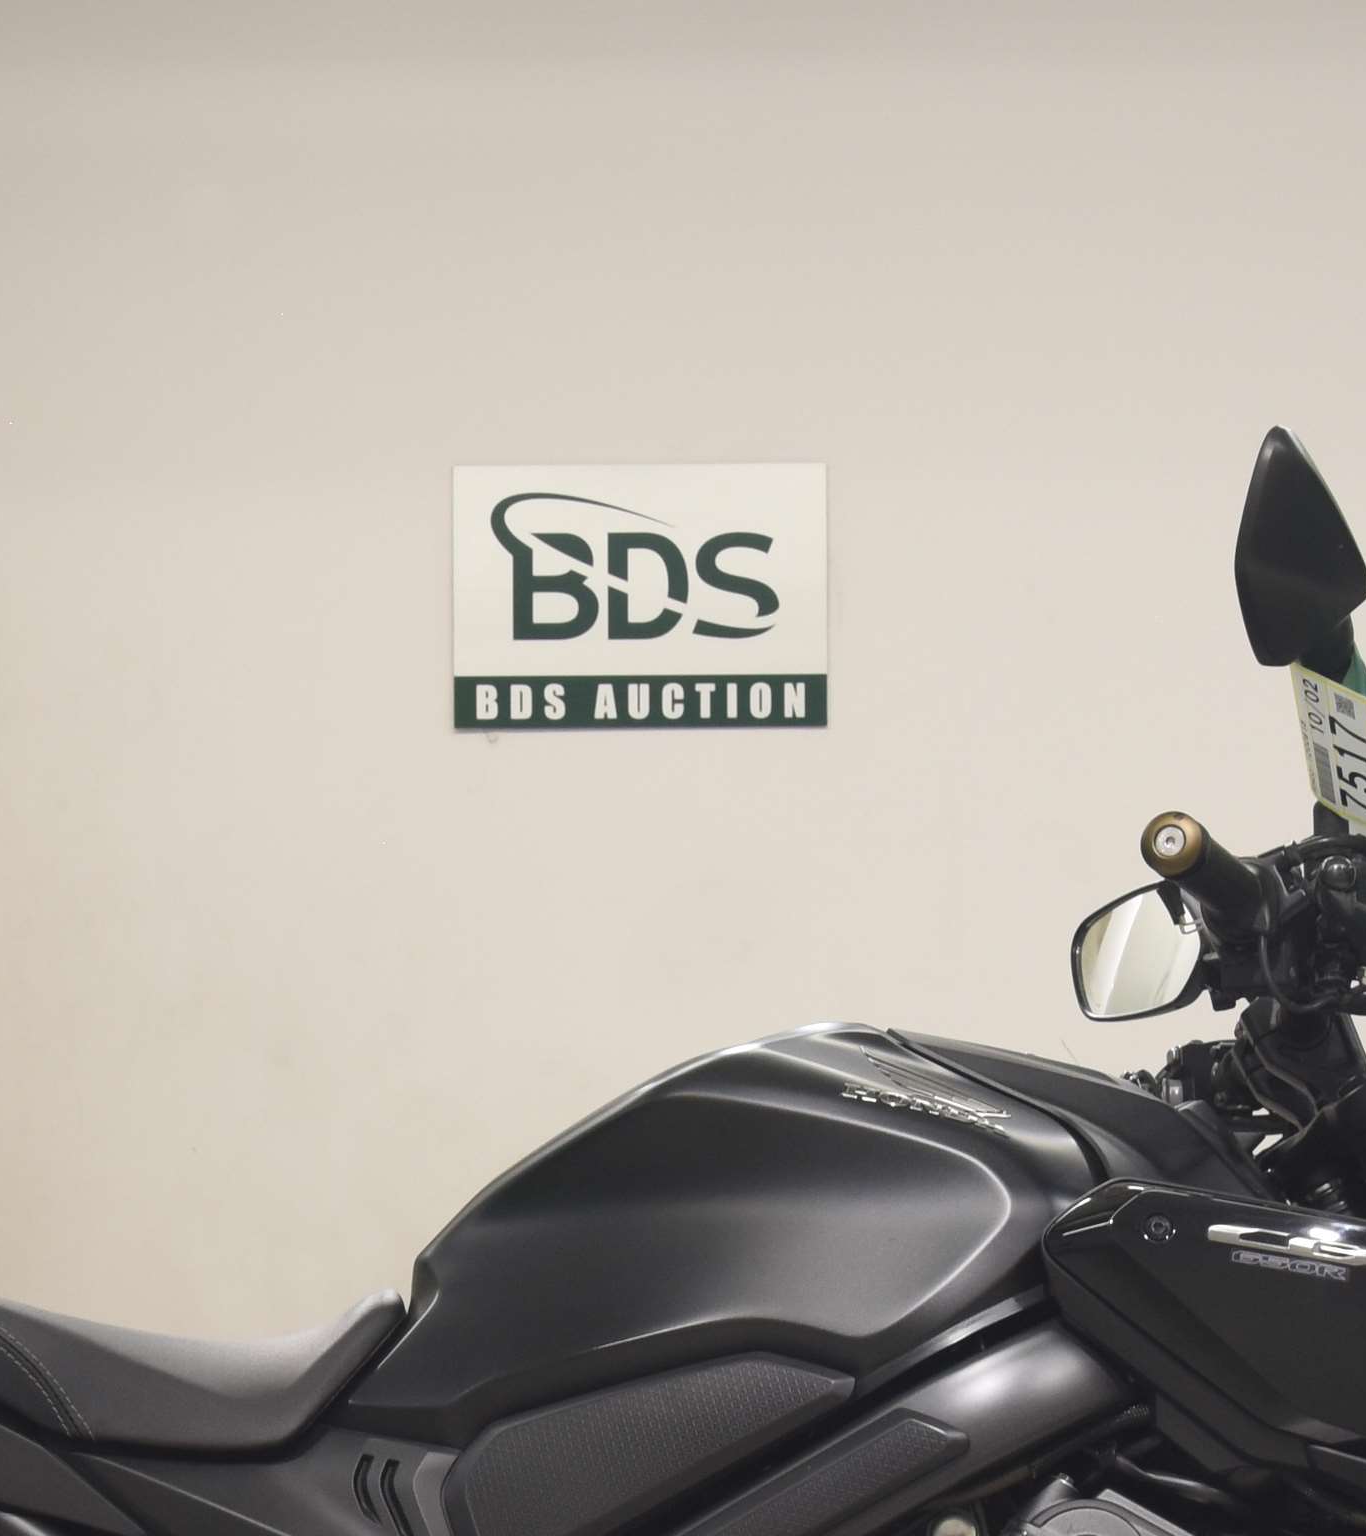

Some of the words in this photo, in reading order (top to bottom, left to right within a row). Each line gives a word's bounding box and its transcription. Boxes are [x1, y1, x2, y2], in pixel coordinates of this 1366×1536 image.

[490, 491, 780, 640] BDS
[474, 683, 567, 720] BDS
[593, 682, 807, 719] AUCTION
[1302, 678, 1325, 736] 10/02
